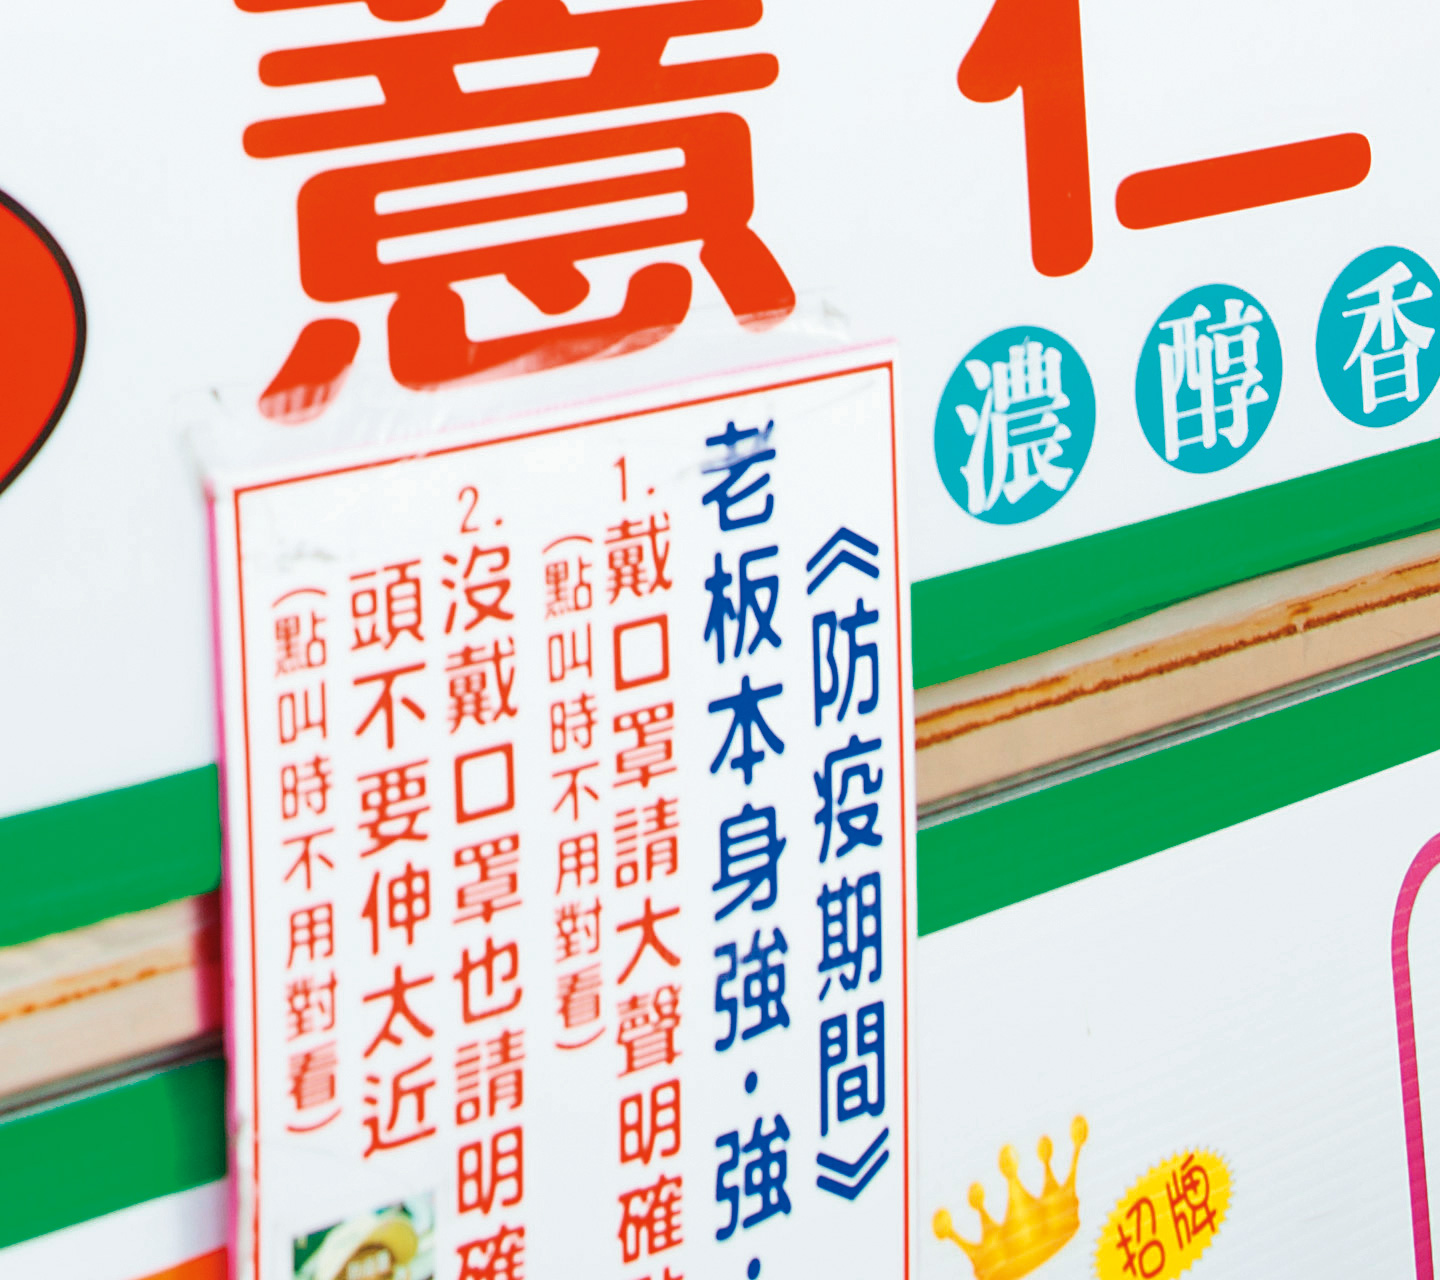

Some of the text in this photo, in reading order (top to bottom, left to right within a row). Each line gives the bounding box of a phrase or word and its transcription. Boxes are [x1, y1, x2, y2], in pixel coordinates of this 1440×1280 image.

[349, 557, 438, 1160] 頭不要伸太近
[604, 454, 684, 1280] 1.戴口罩請大聲明確
